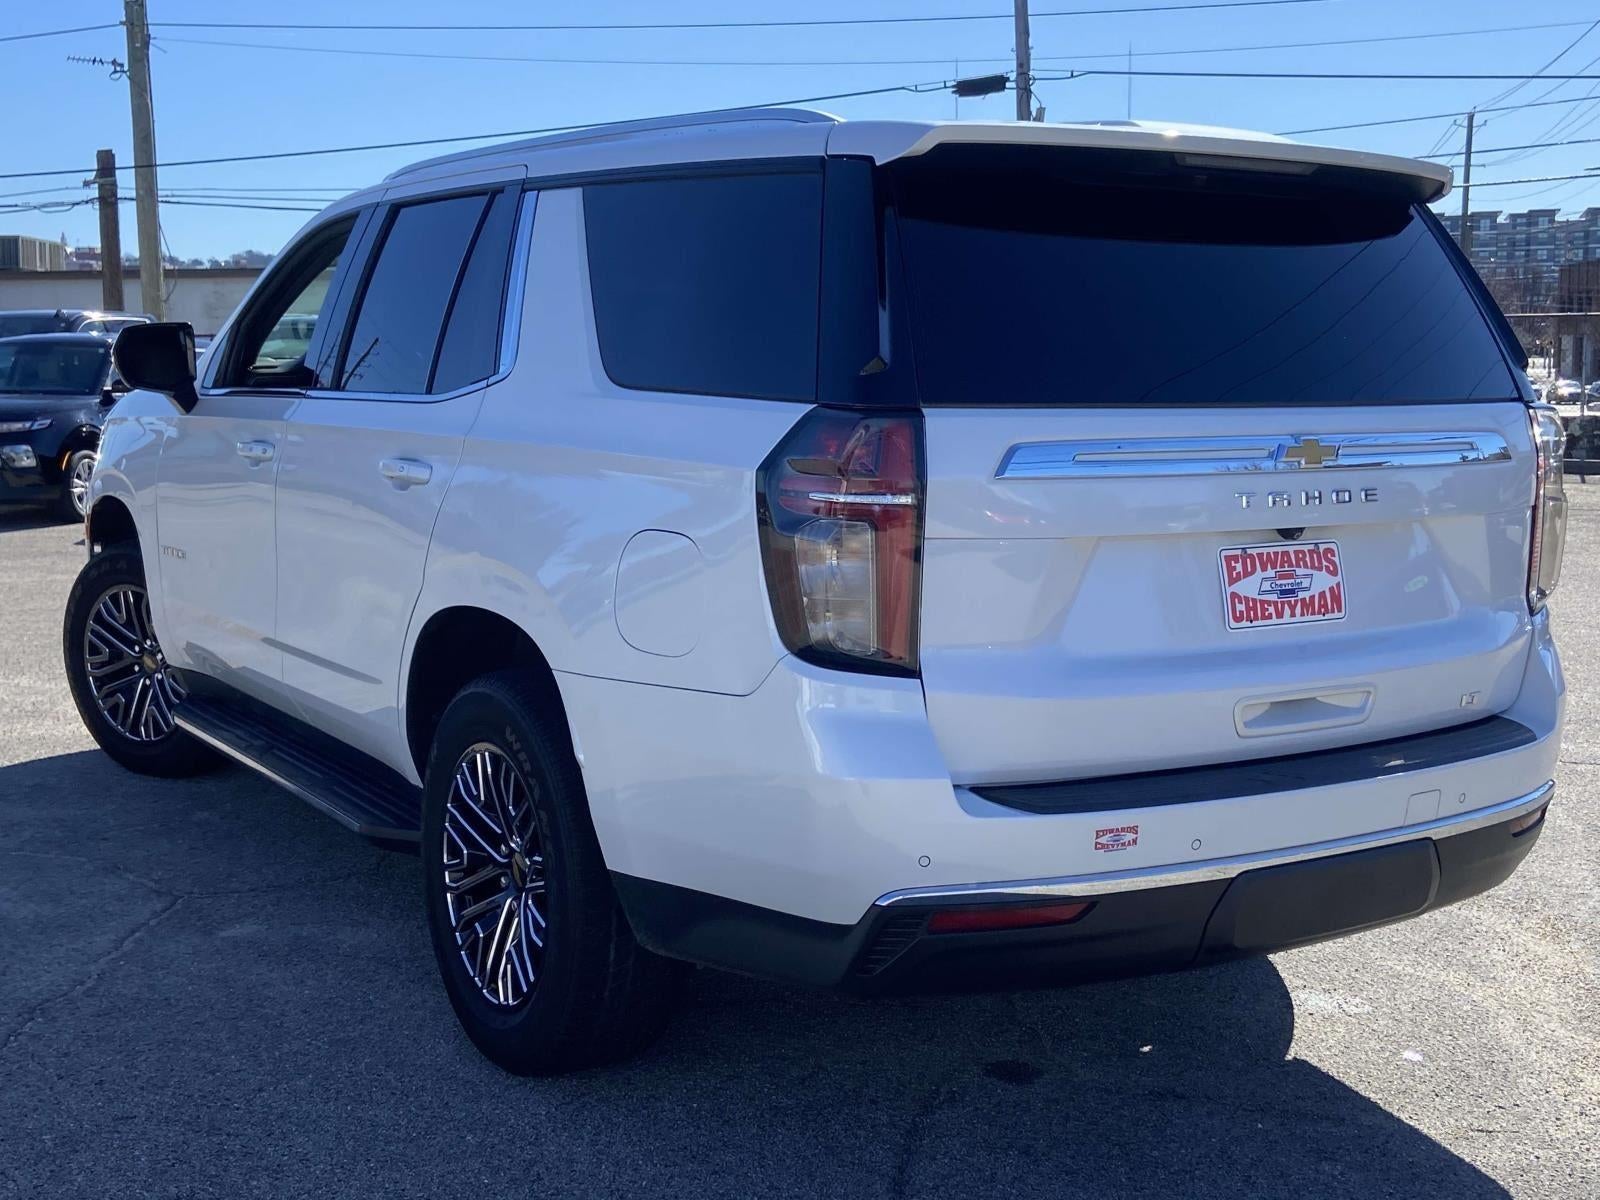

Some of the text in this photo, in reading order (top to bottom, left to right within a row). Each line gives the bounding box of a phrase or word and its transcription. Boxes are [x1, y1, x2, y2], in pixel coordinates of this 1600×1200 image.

[1234, 488, 1379, 509] TAHOE
[1224, 547, 1339, 588] EDWARDS
[1269, 580, 1304, 590] Chevrolet
[1229, 581, 1343, 624] CHEVYMAN
[1095, 825, 1139, 840] EDWARDS
